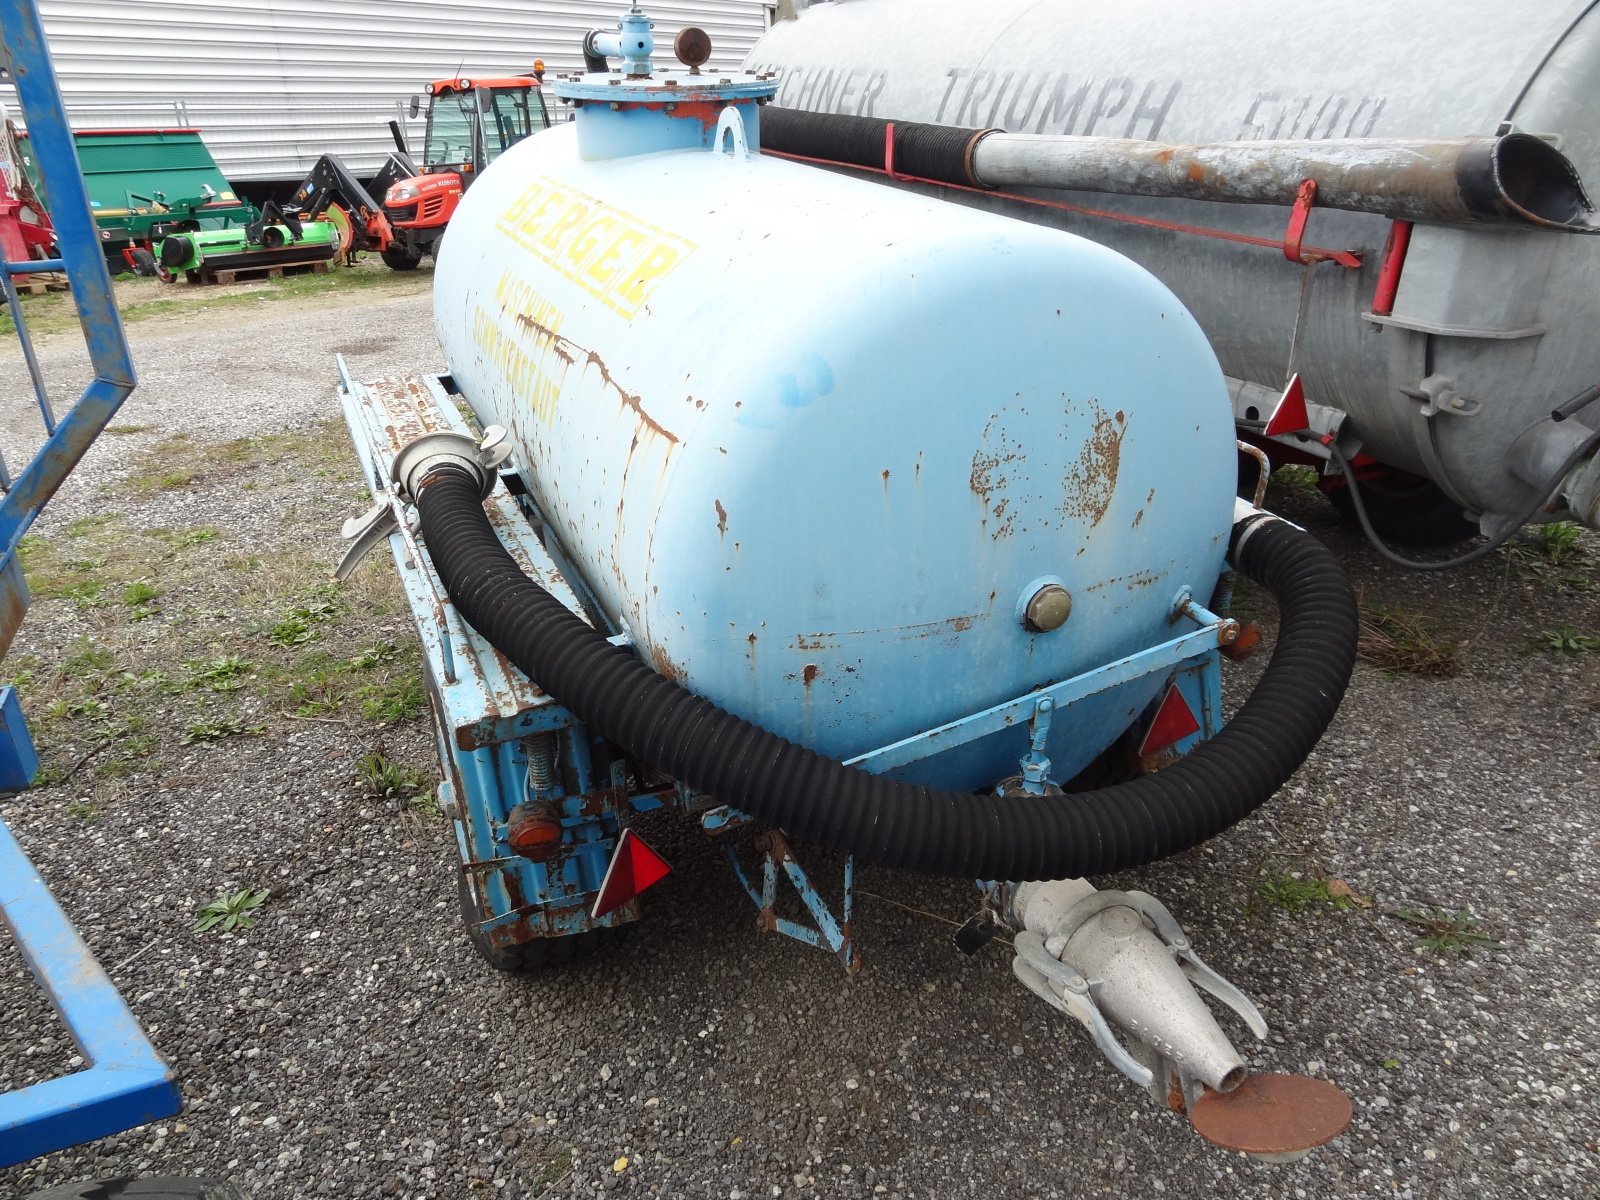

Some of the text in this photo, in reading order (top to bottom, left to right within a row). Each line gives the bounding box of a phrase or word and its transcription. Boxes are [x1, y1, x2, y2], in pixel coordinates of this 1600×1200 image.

[934, 67, 1183, 142] TRIUMPH
[437, 179, 461, 187] KUBOTA
[502, 182, 678, 304] BERGER
